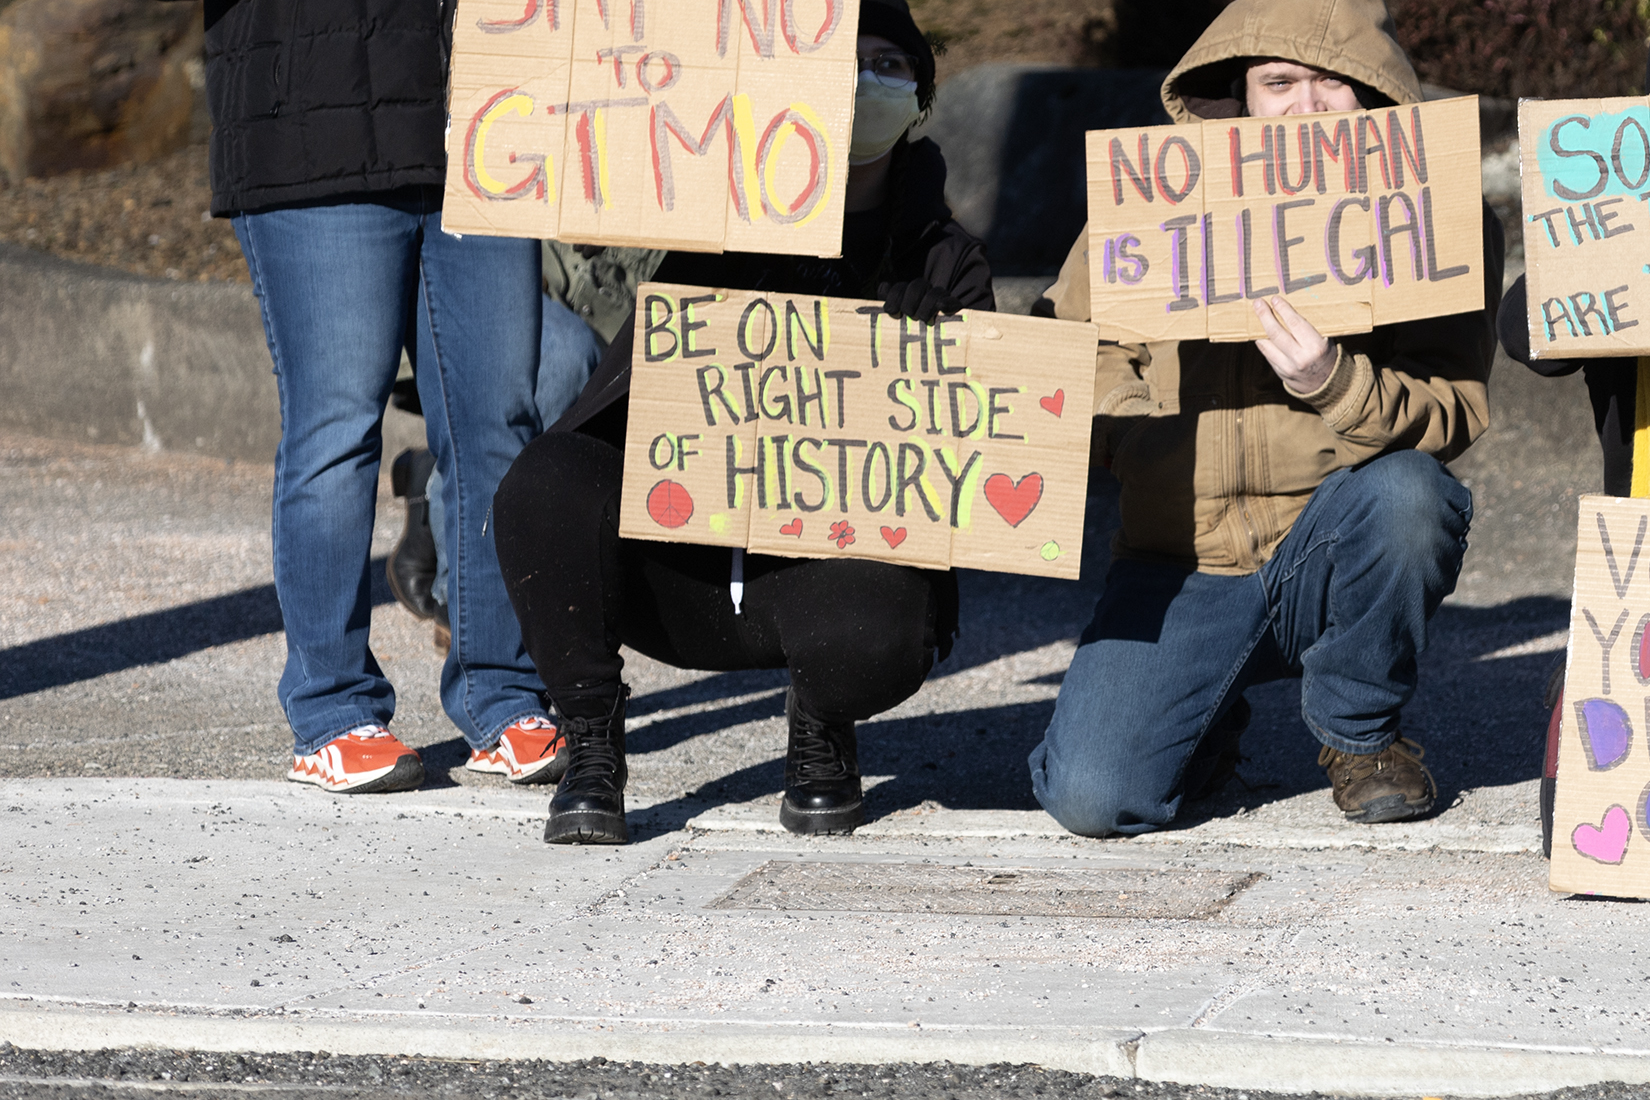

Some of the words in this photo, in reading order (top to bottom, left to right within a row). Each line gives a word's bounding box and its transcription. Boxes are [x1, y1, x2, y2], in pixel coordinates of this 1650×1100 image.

[597, 45, 682, 93] TO
[463, 87, 835, 227] GTMO
[1108, 133, 1201, 206] NO
[1228, 106, 1428, 197] HUMAN
[1103, 232, 1150, 285] IS
[1160, 186, 1470, 313] ILLEGAL
[1528, 198, 1634, 248] THE
[643, 293, 725, 363] BE
[736, 297, 831, 362] ON
[856, 306, 972, 377] THE
[1540, 284, 1639, 342] ARE
[696, 361, 862, 428] RIGHT
[887, 378, 1028, 444] SIDE
[649, 431, 704, 471] OF
[726, 434, 983, 530] HISTORY
